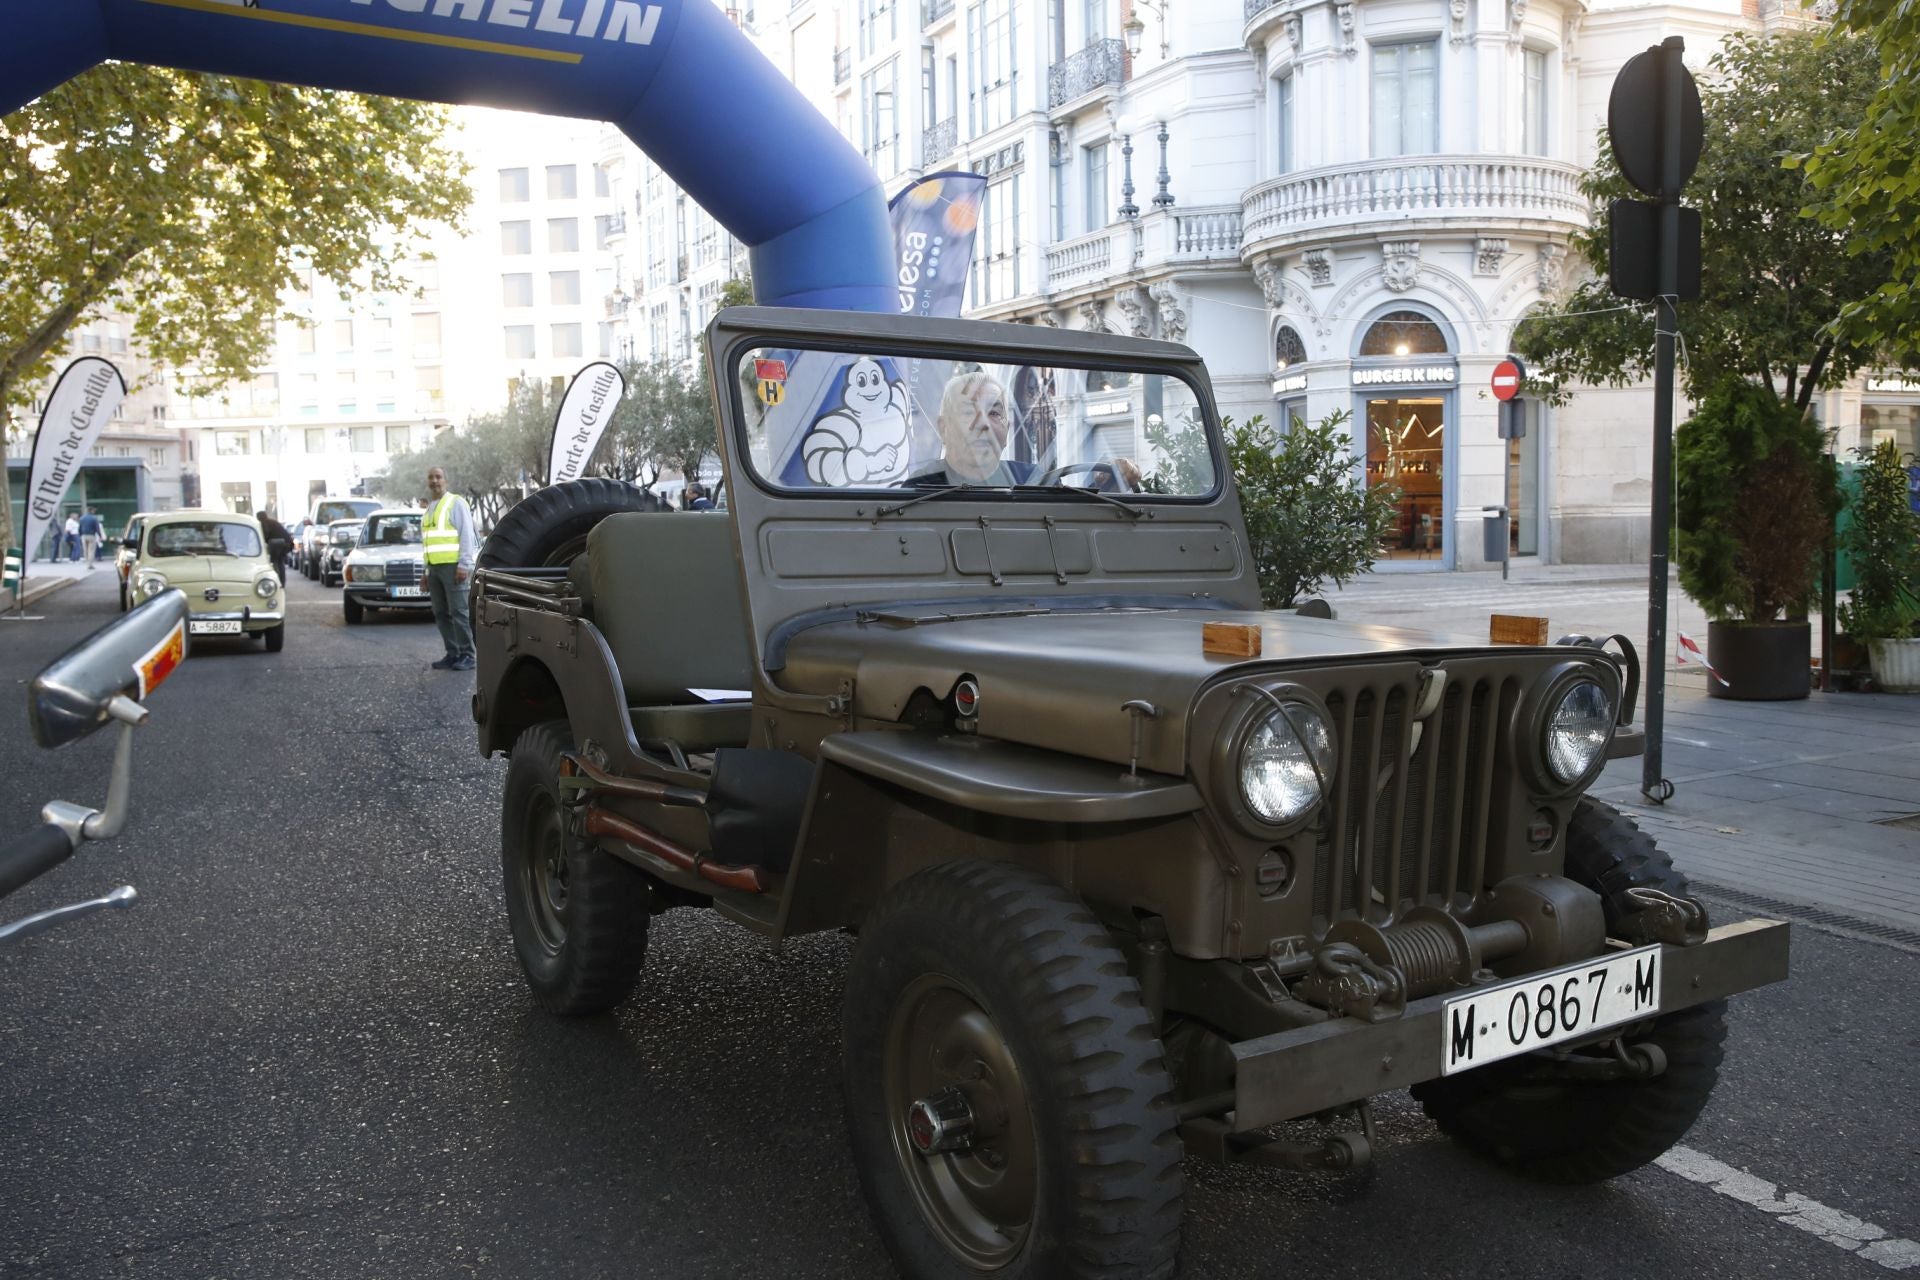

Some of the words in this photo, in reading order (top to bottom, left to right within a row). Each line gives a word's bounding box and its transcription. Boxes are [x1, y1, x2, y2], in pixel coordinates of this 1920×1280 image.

[1352, 368, 1413, 384] BURGER
[1413, 367, 1455, 382] KING
[70, 367, 114, 431] Castilla
[580, 370, 617, 426] Castilla
[764, 381, 779, 403] H
[59, 432, 83, 450] de
[571, 427, 591, 444] de
[38, 451, 75, 496] Norte
[33, 496, 55, 521] El
